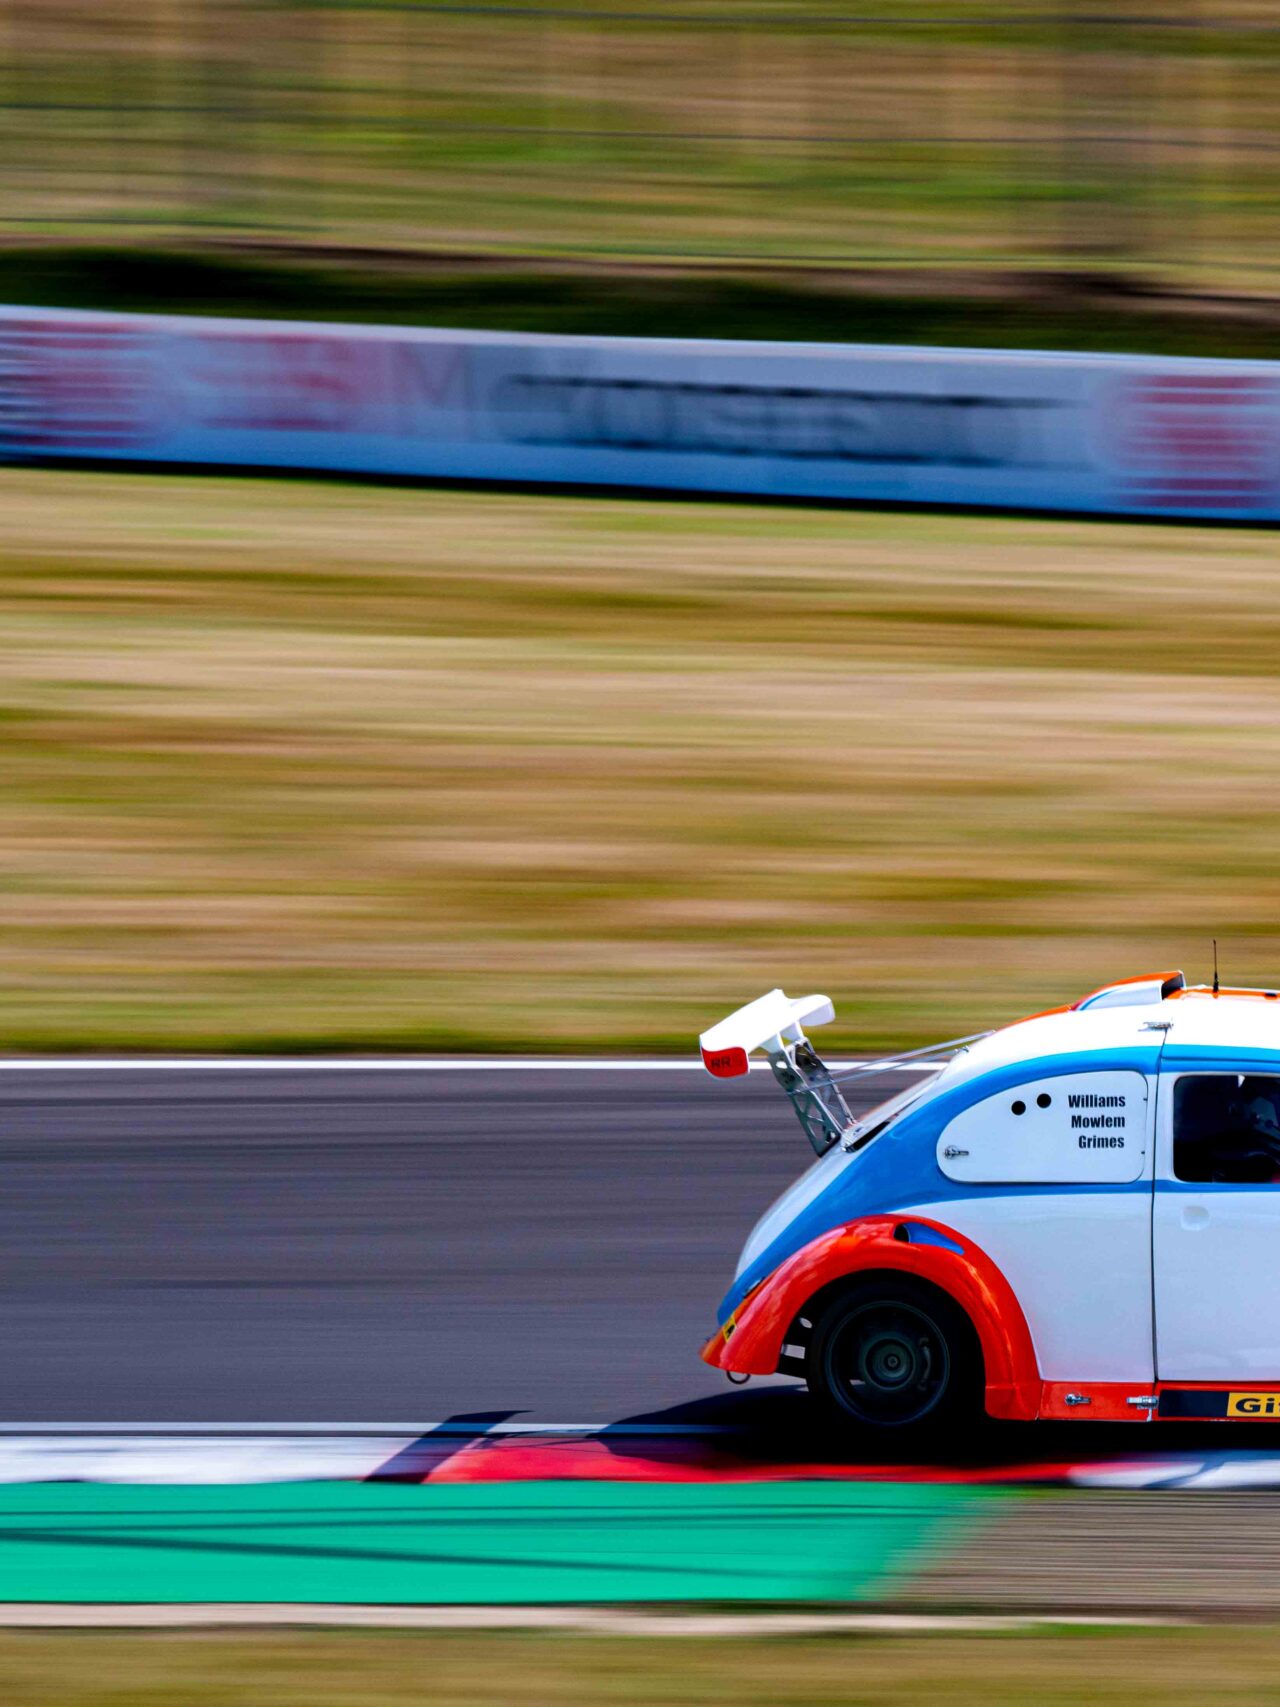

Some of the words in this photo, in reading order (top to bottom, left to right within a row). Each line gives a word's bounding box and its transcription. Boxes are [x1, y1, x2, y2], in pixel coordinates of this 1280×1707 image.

[1068, 1094, 1126, 1108] Williams
[1071, 1114, 1125, 1128] Mowlem
[1078, 1134, 1125, 1149] Grimes
